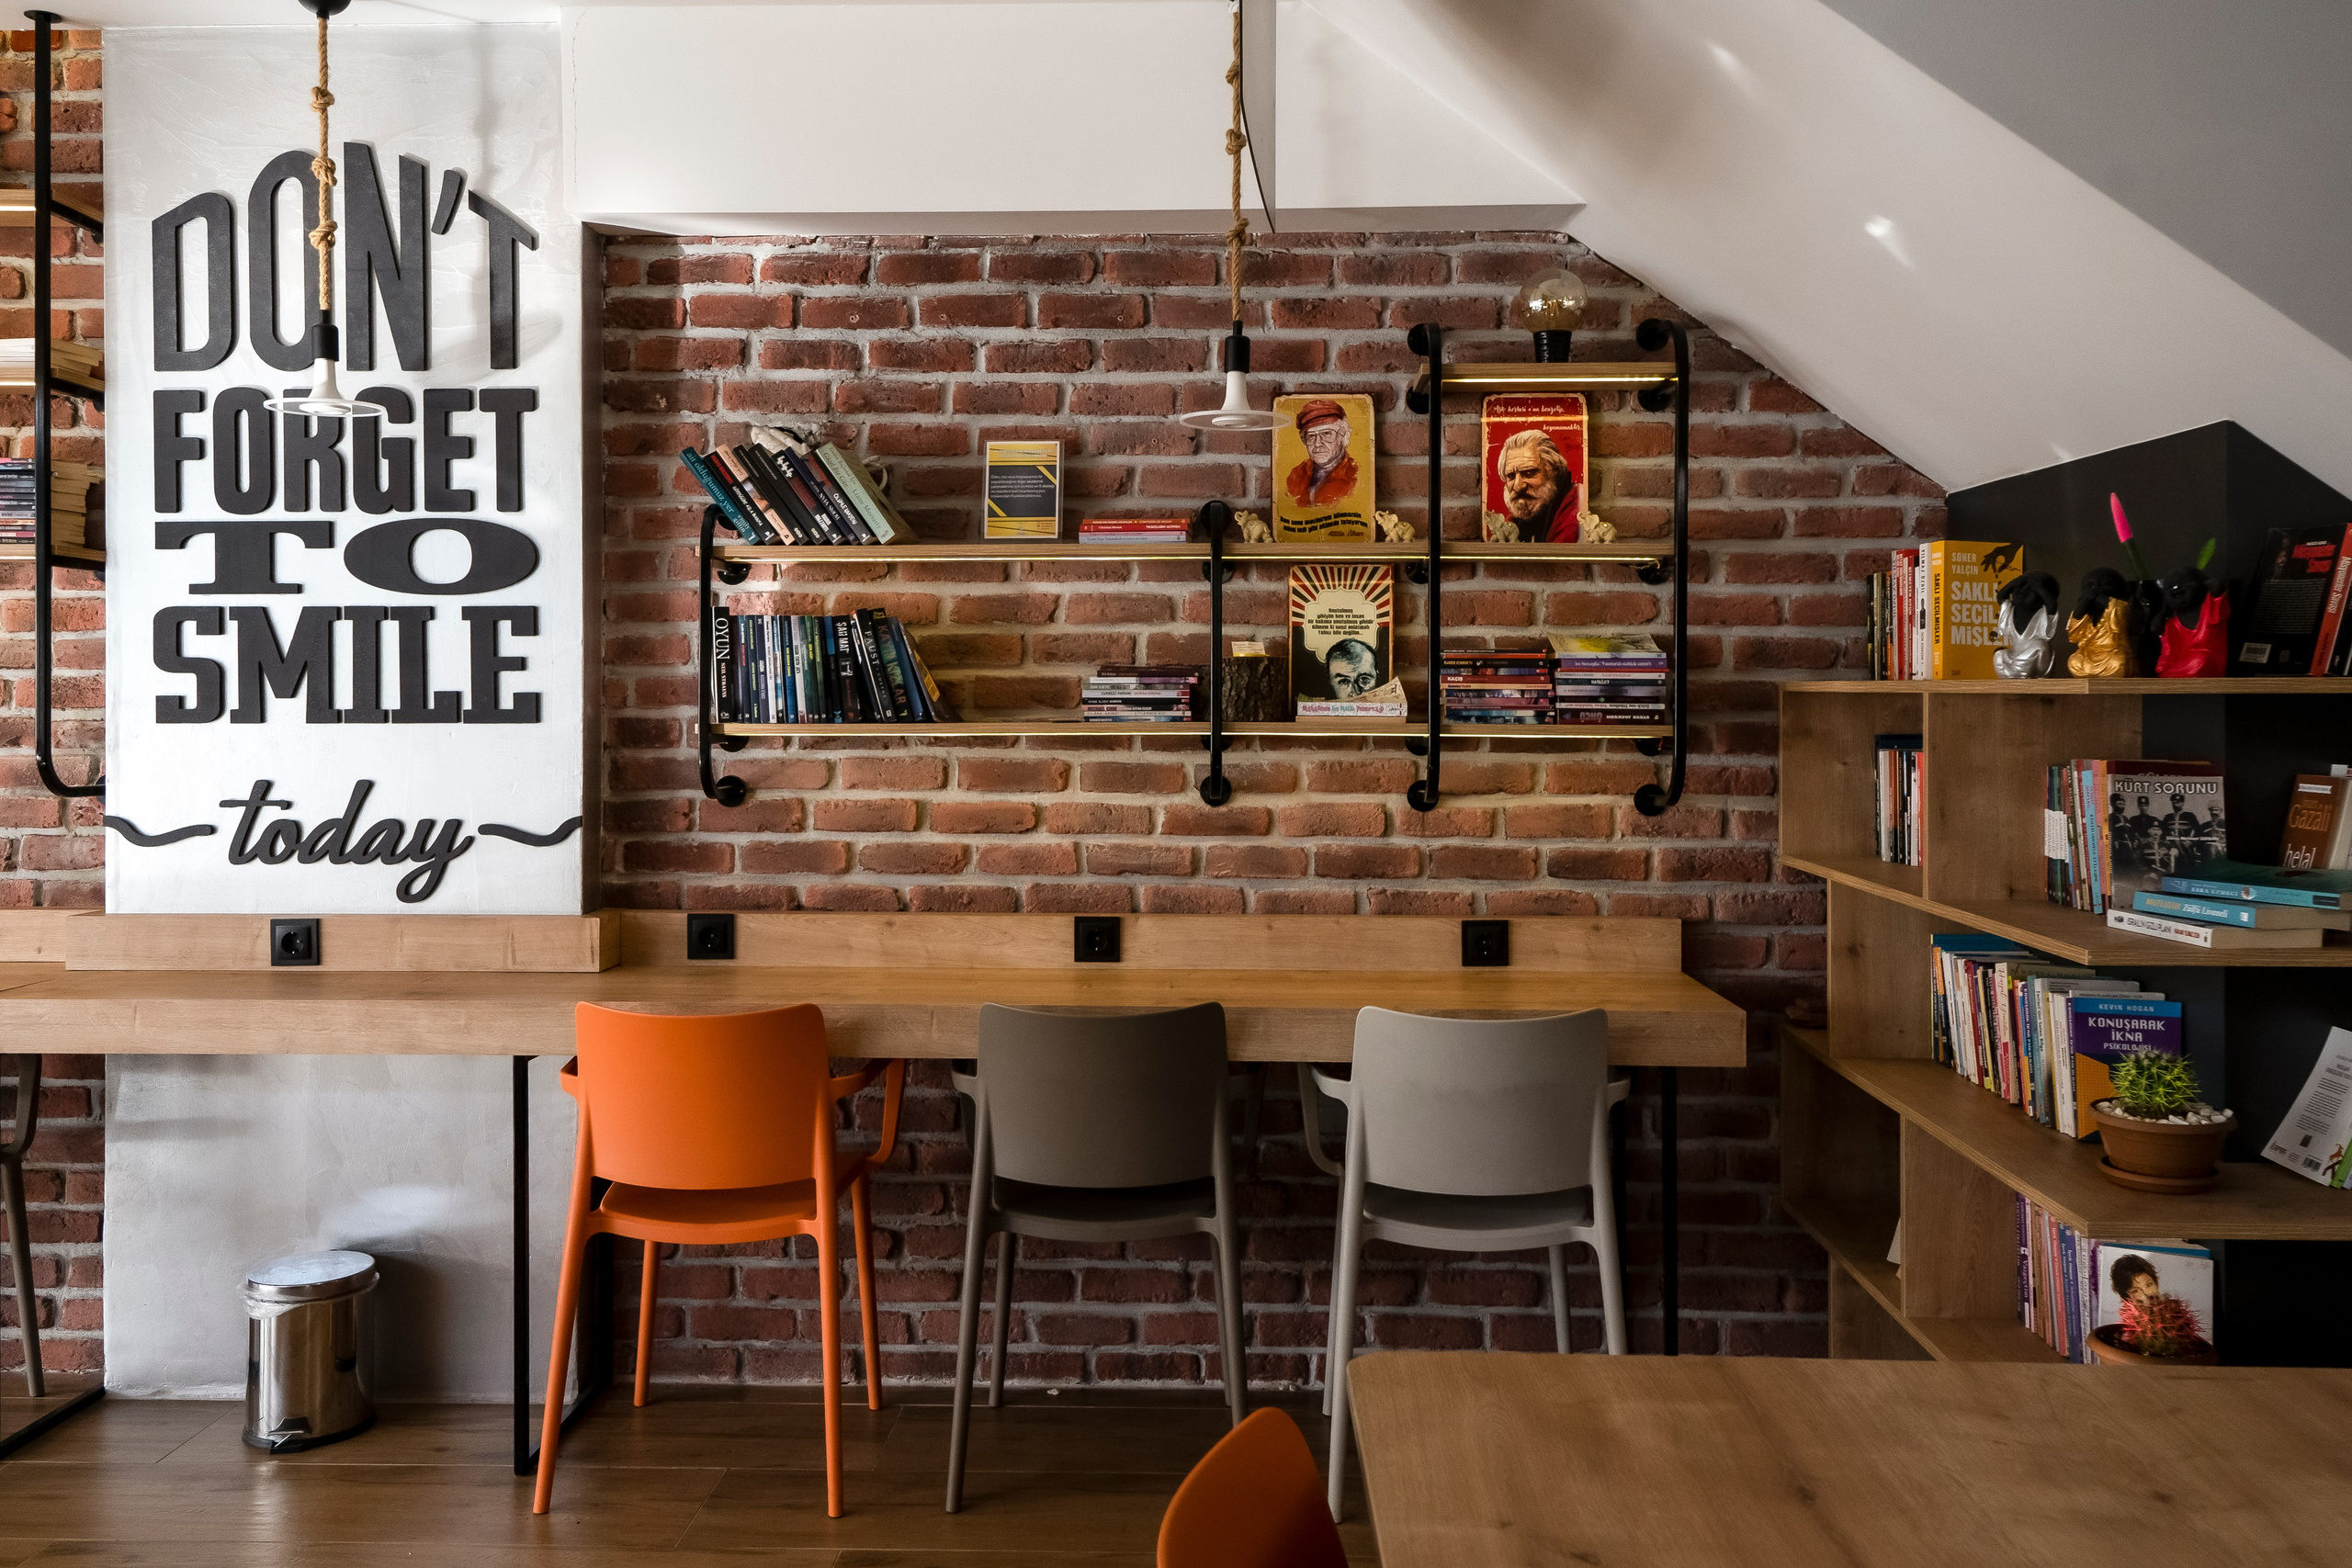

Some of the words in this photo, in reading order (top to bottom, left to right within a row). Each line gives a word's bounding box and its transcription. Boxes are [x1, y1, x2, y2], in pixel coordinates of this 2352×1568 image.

[152, 141, 540, 373] DON'T
[153, 386, 540, 514] FORGET
[684, 452, 696, 464] ait
[691, 461, 726, 502] olduğumuz
[719, 499, 734, 515] yer
[862, 503, 883, 529] Moriarty
[154, 517, 540, 595] TO
[1951, 552, 1977, 563] SONER
[1951, 565, 1979, 576] YALÇIN
[714, 617, 729, 660] OYUN
[838, 637, 850, 654] MAT
[864, 629, 879, 666] FAUST
[154, 604, 542, 724] SMILE
[2115, 779, 2150, 793] KÜRT
[2154, 782, 2217, 795] SORUNU
[219, 779, 477, 904] today
[2282, 844, 2316, 869] helal
[2098, 1003, 2123, 1011] KEVIN
[2088, 1017, 2165, 1032] KONUŞARAK
[2111, 1030, 2143, 1042] İKNA
